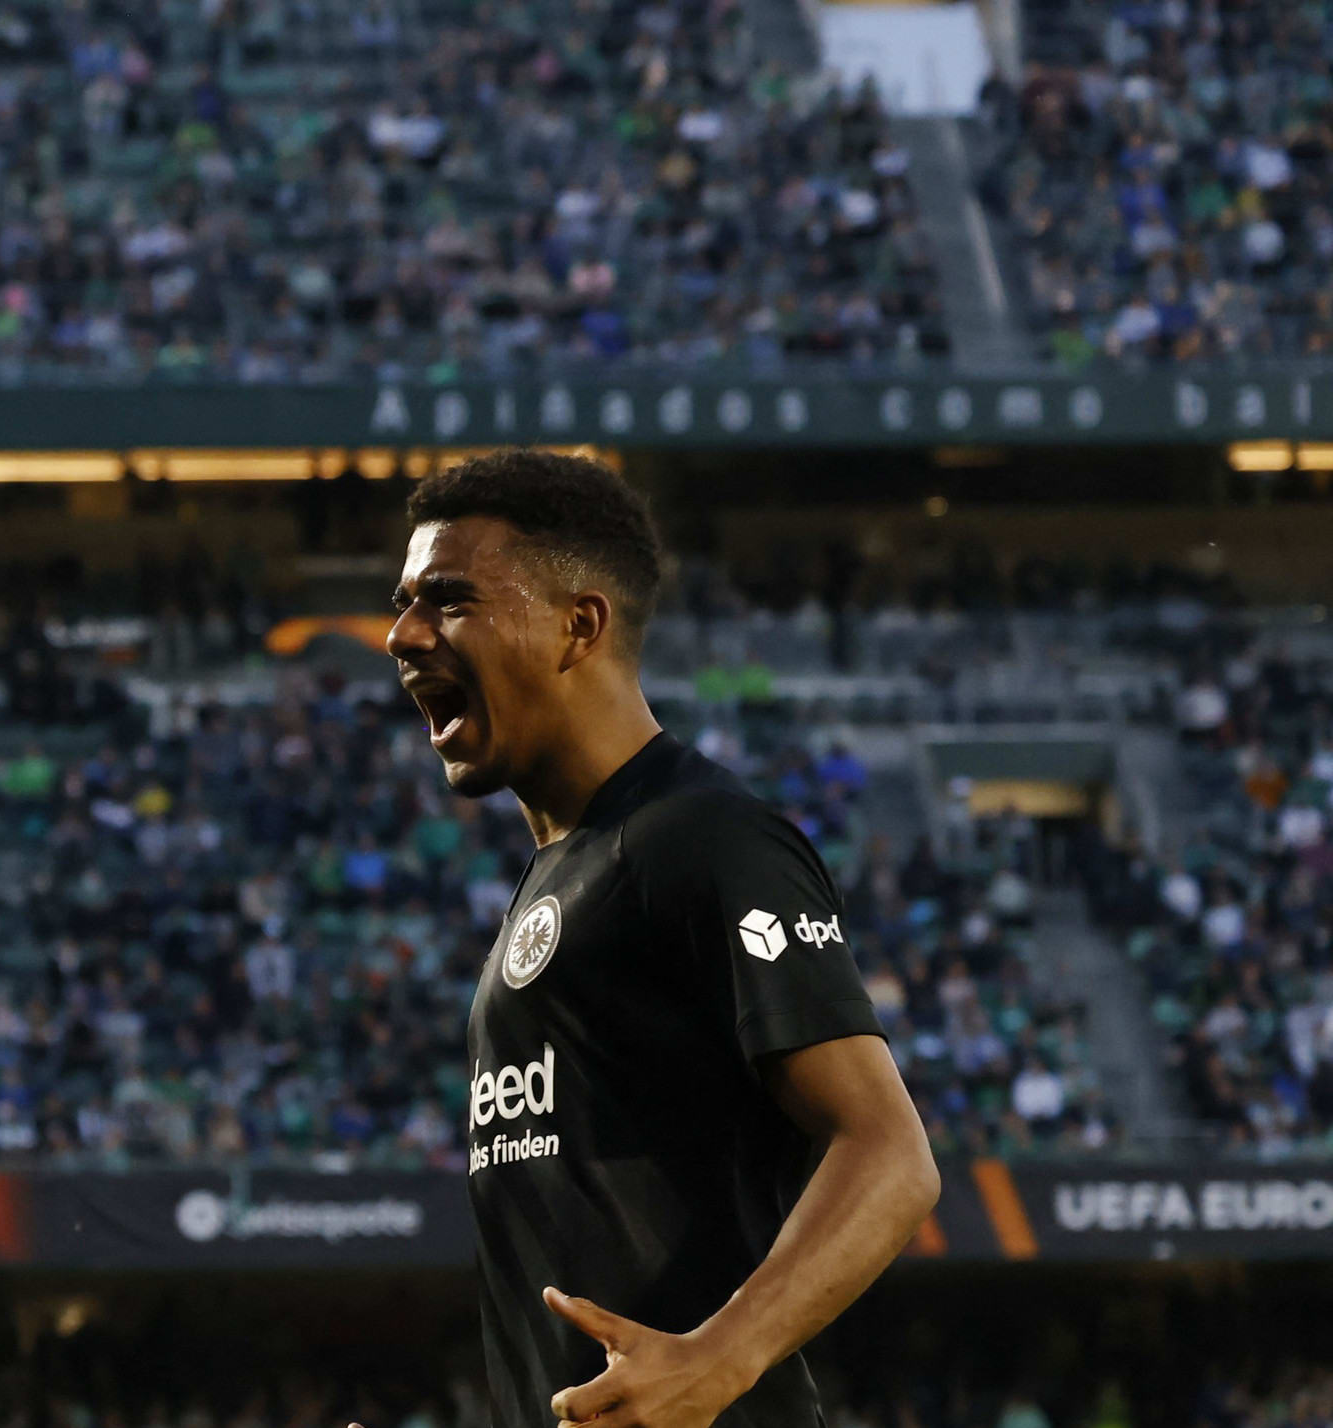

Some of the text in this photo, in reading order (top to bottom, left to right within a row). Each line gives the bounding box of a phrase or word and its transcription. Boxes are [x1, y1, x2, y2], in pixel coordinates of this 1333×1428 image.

[794, 912, 844, 949] dpd
[492, 1129, 560, 1165] finden
[1054, 1182, 1194, 1231] UEFA
